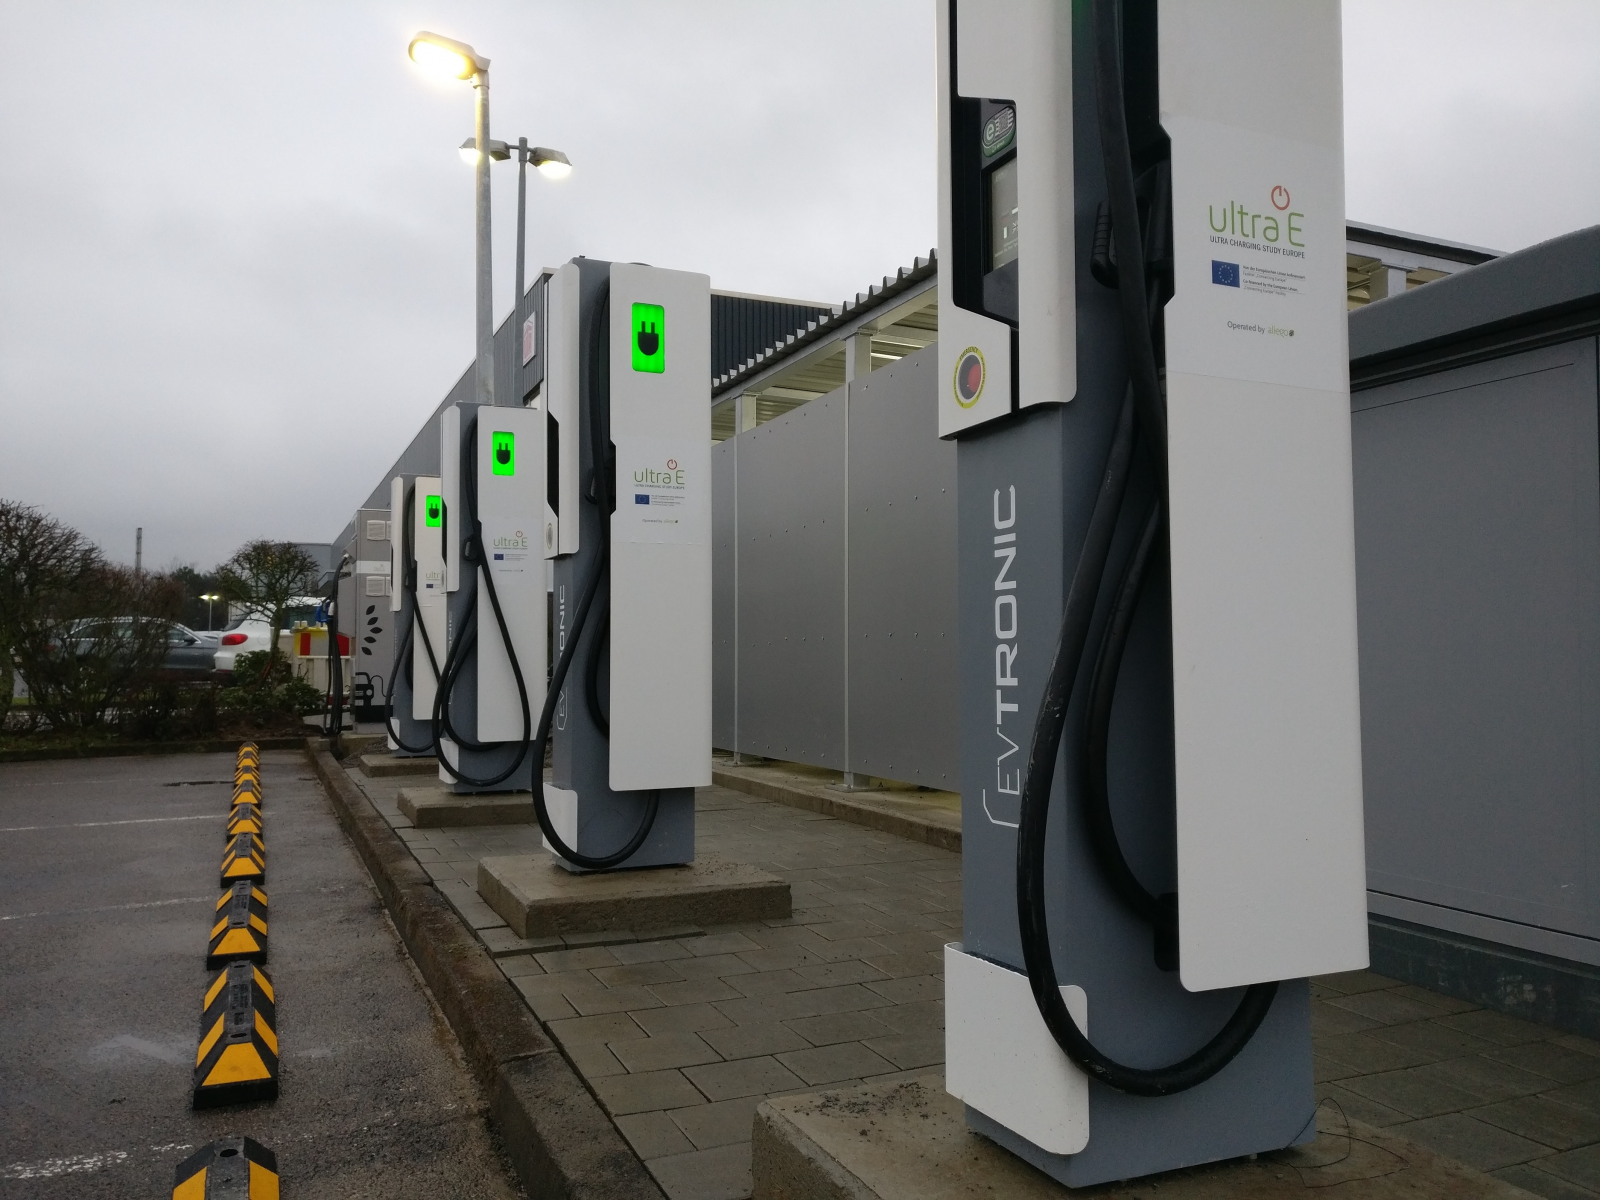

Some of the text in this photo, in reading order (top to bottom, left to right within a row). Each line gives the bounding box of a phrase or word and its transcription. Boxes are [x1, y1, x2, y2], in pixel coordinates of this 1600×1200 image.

[1209, 200, 1306, 248] ultra E
[1210, 236, 1305, 258] ULTRA CHARGING STUDY EUROPE
[1227, 320, 1288, 338] Operated by allego
[634, 468, 685, 485] ultra E
[494, 537, 518, 547] ultra
[994, 484, 1021, 796] EVTRONIC
